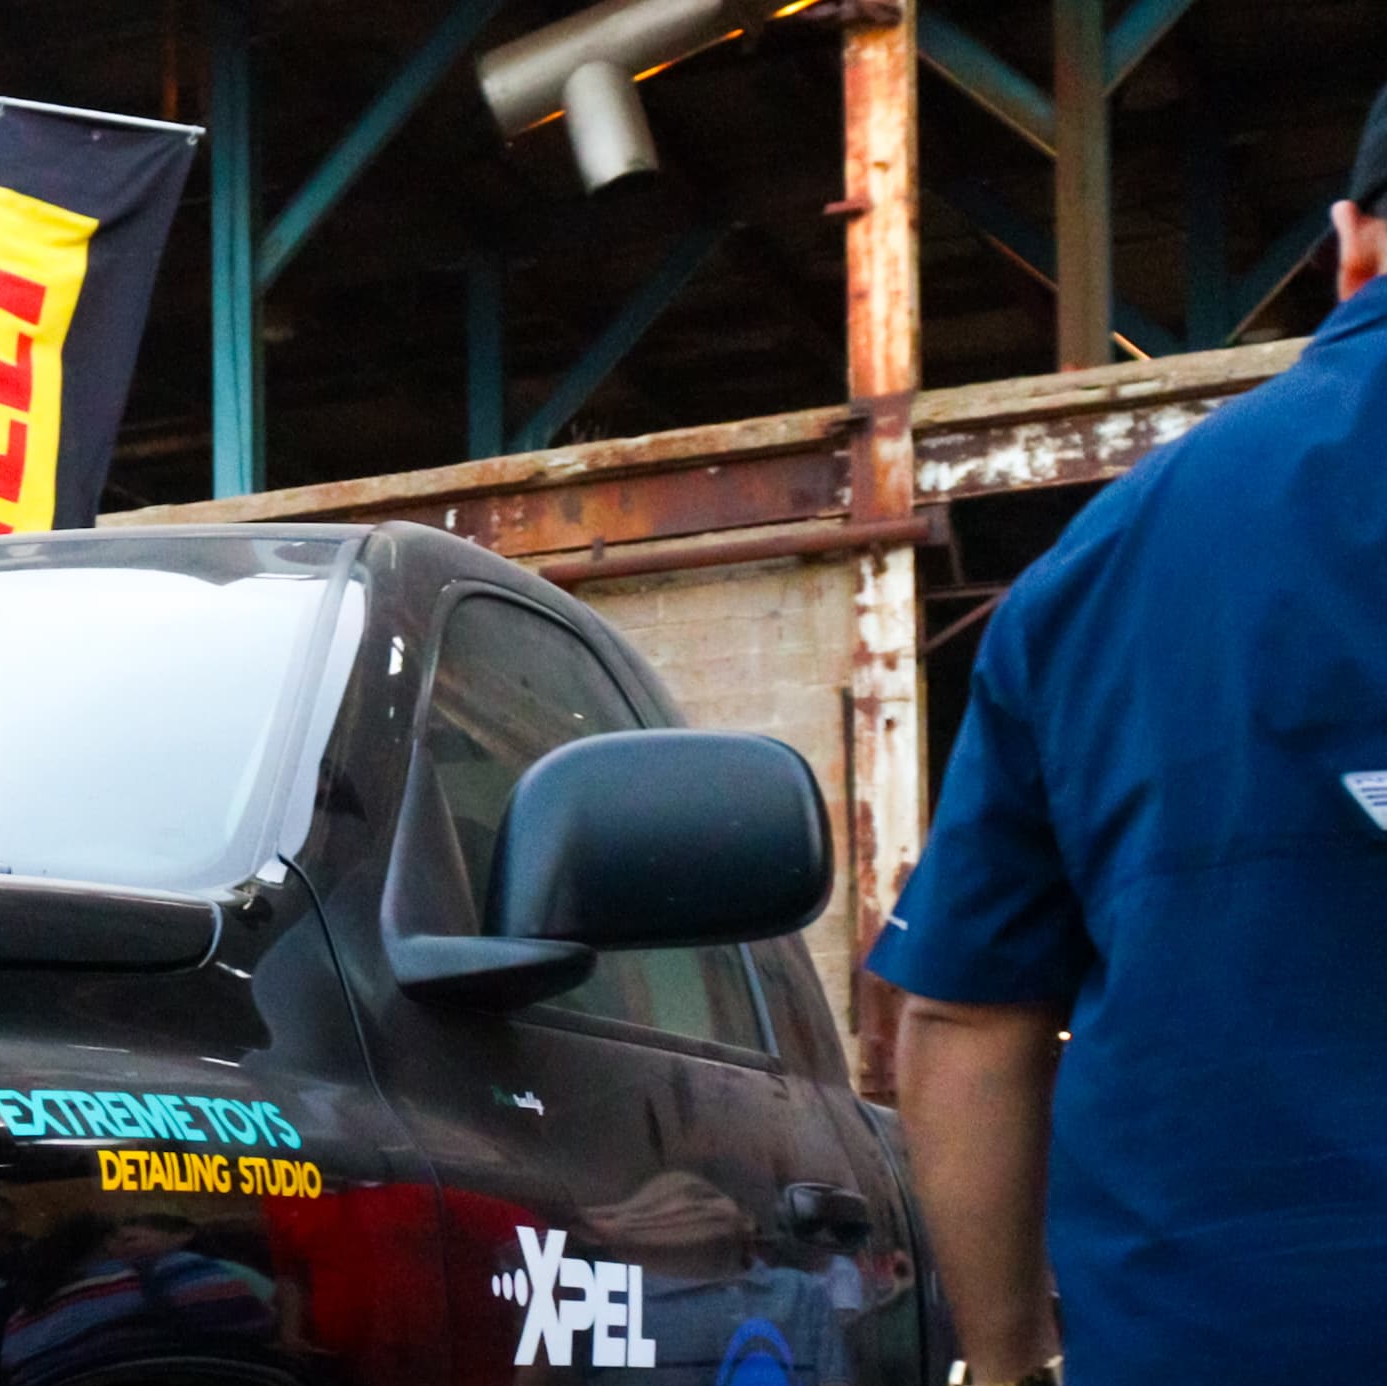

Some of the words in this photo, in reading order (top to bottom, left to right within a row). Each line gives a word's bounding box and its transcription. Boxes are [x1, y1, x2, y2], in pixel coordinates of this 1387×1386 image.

[189, 1095, 303, 1150] TOYS
[97, 1150, 231, 1194] DETAILING
[237, 1155, 323, 1200] STUDIO
[513, 1225, 657, 1369] XPEL
